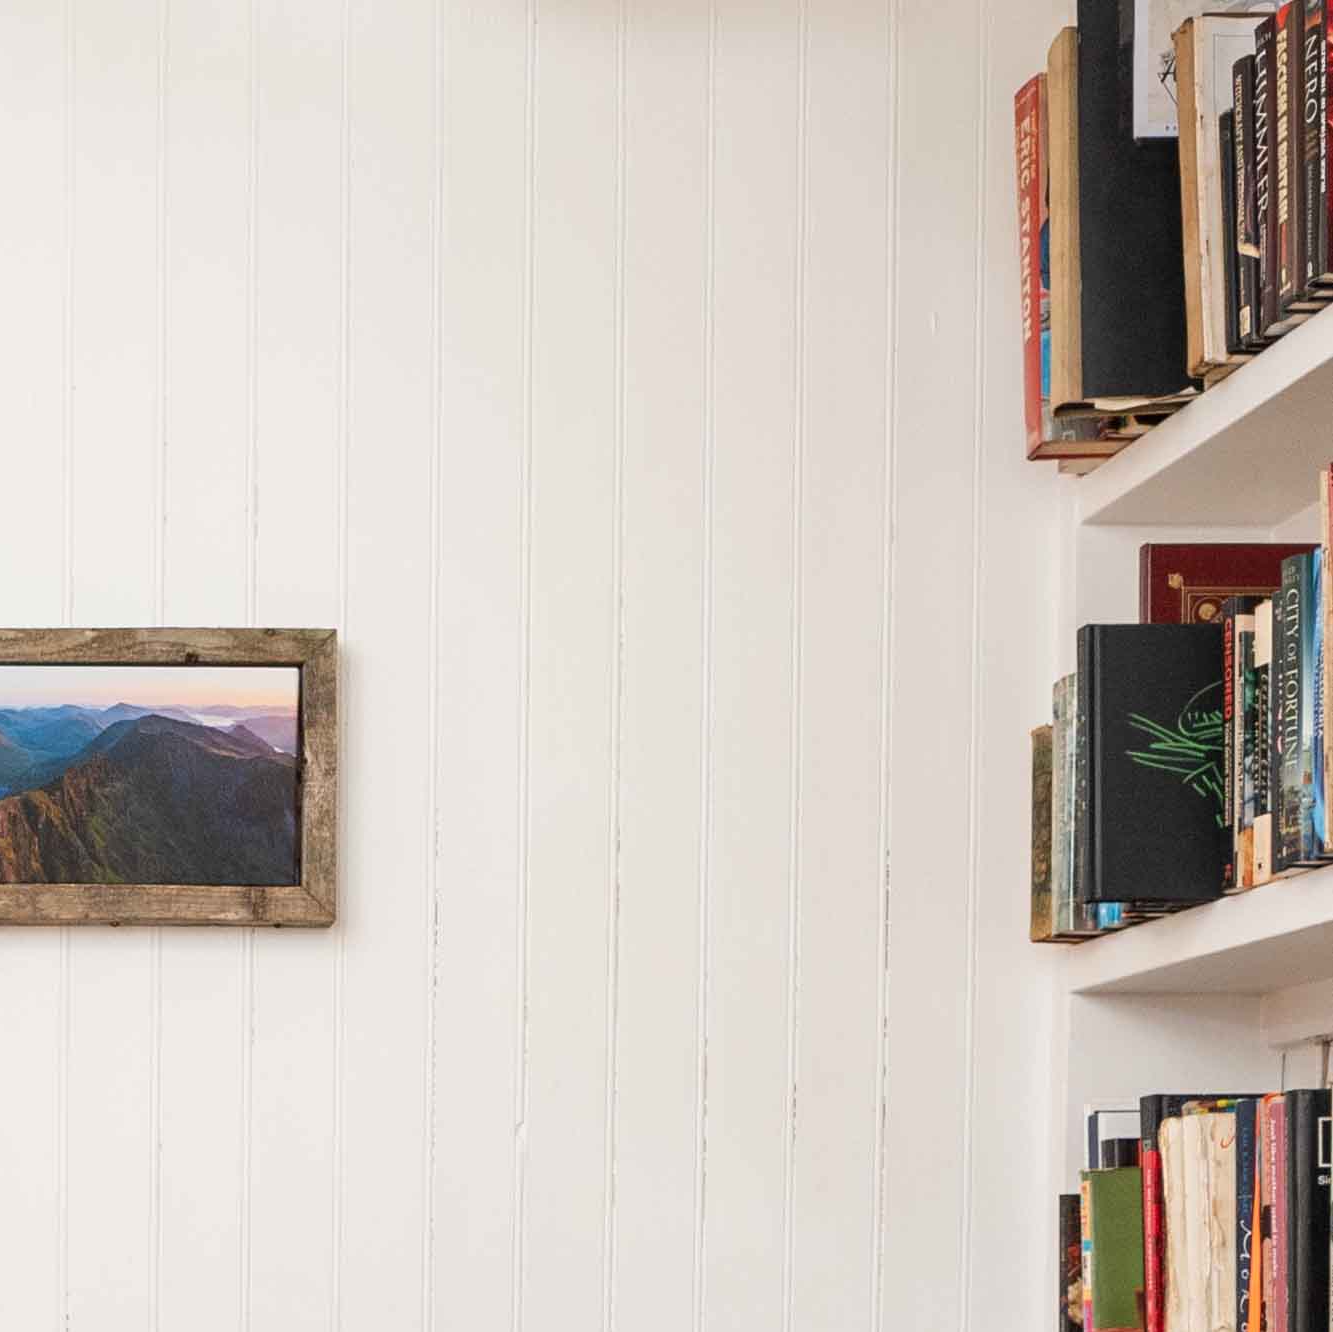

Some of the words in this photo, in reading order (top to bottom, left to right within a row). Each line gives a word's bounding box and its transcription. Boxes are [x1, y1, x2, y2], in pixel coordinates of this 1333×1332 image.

[1276, 28, 1288, 117] FASCISM
[1304, 34, 1318, 123] NERO
[1020, 115, 1031, 189] ERIC
[1255, 49, 1268, 223] HIMMLER
[1019, 197, 1032, 344] STANTON
[1286, 588, 1299, 638] CITY
[1224, 617, 1233, 720] CENSORED
[1285, 669, 1299, 769] FORTUNE
